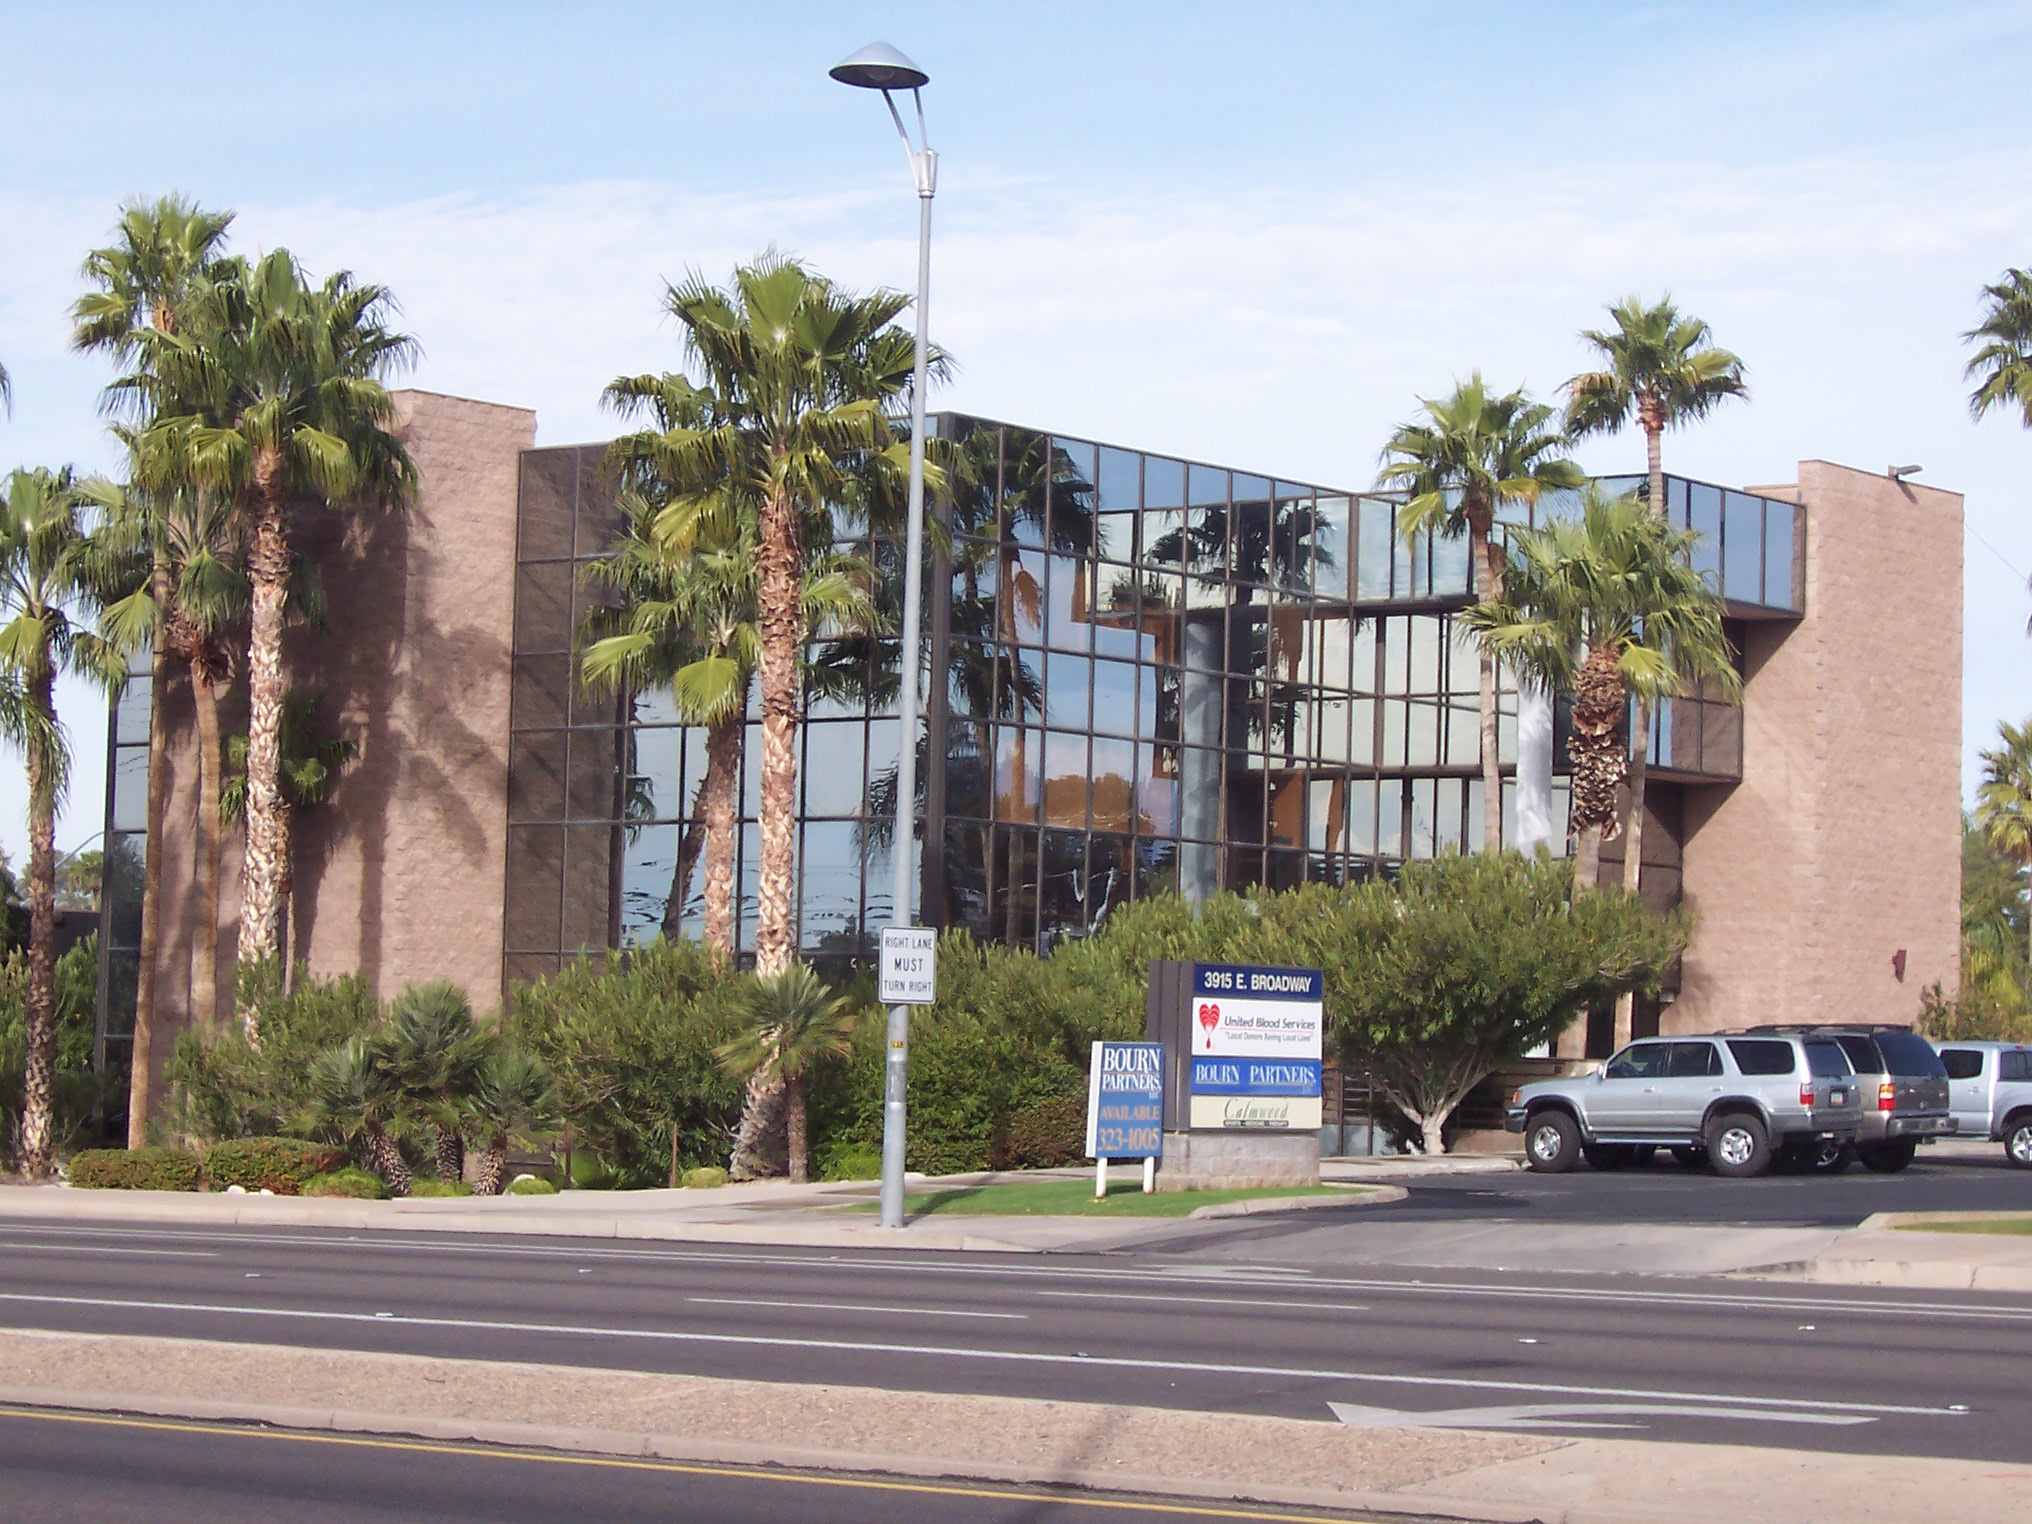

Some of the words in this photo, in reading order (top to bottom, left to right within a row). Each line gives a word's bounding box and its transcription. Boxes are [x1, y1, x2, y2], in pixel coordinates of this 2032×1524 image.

[885, 936, 909, 949] RIGHT
[912, 937, 933, 950] LANE
[894, 957, 923, 972] MUST
[884, 980, 905, 992] TURN
[908, 980, 932, 993] RIGHT
[1204, 971, 1232, 989] 3915
[1236, 973, 1247, 990] E.
[1251, 973, 1312, 993] BROADWAY
[1224, 1016, 1254, 1028] United
[1256, 1016, 1280, 1028] Blood
[1282, 1018, 1316, 1030] Services
[1103, 1047, 1161, 1074] BOURN
[1195, 1064, 1240, 1083] BOURN
[1101, 1105, 1160, 1120] AVAILABLE
[1097, 1127, 1160, 1151] 323-1005
